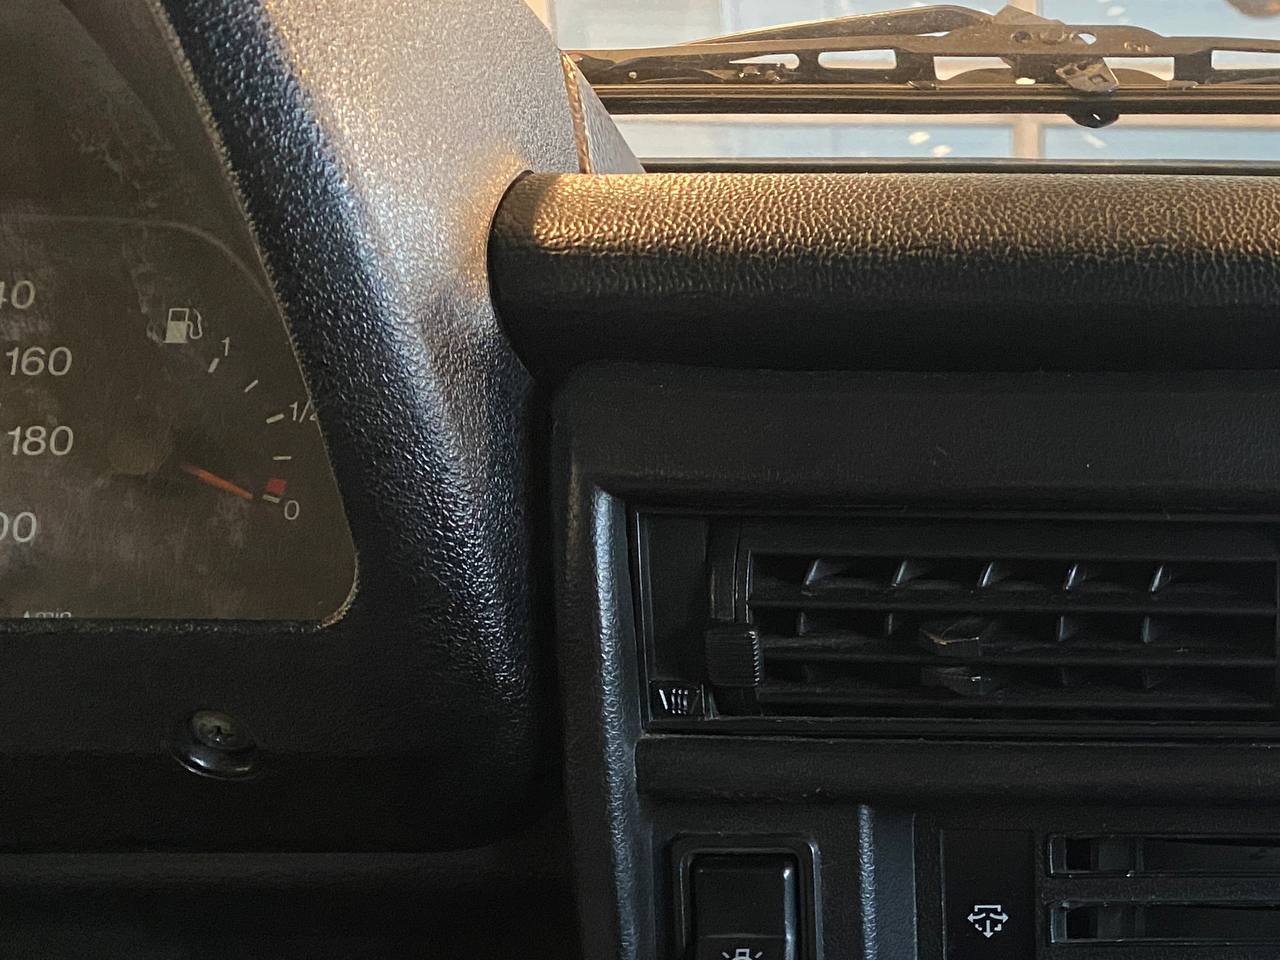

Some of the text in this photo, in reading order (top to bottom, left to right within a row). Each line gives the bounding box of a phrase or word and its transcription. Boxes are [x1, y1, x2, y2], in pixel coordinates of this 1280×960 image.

[0, 280, 36, 310] 0
[5, 346, 73, 376] 160
[220, 336, 230, 357] 1
[7, 425, 74, 456] 180
[283, 499, 300, 521] 0
